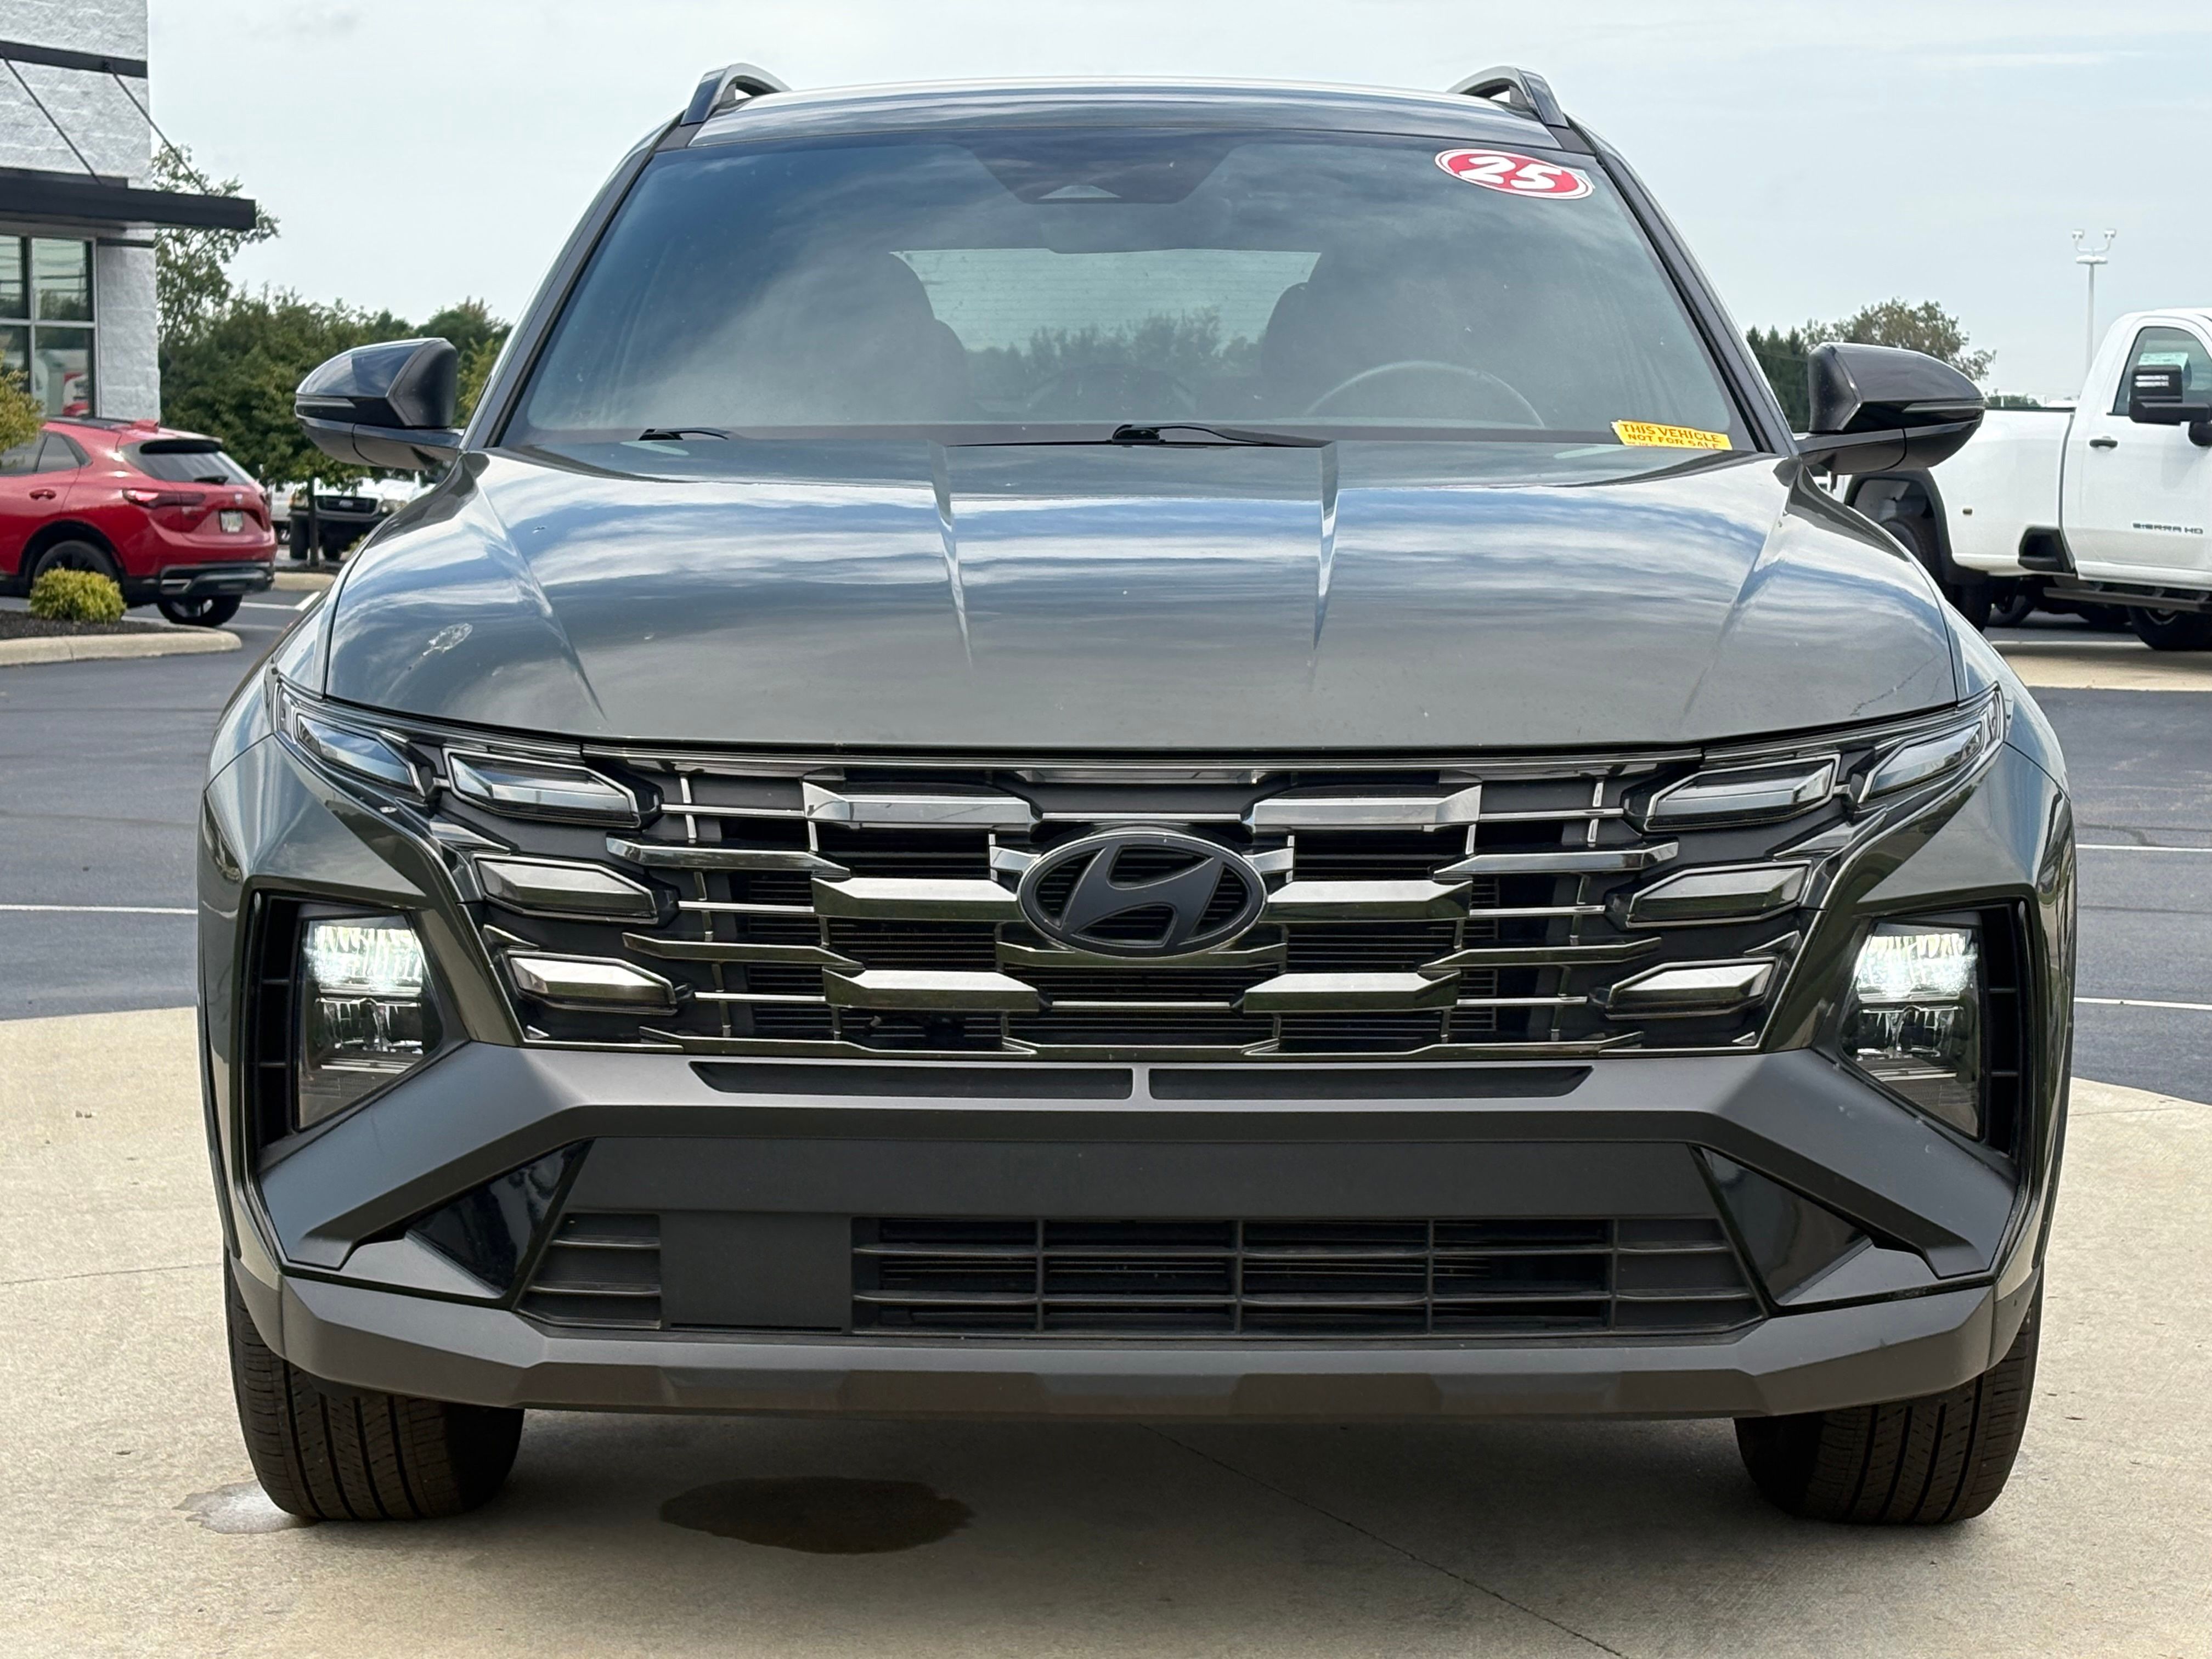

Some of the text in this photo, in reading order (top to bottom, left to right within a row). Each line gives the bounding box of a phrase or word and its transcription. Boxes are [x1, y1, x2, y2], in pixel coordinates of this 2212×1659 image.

[1459, 156, 1562, 190] 25
[1622, 424, 1720, 443] THIS VEHICLE
[1628, 434, 1654, 442] NOT
